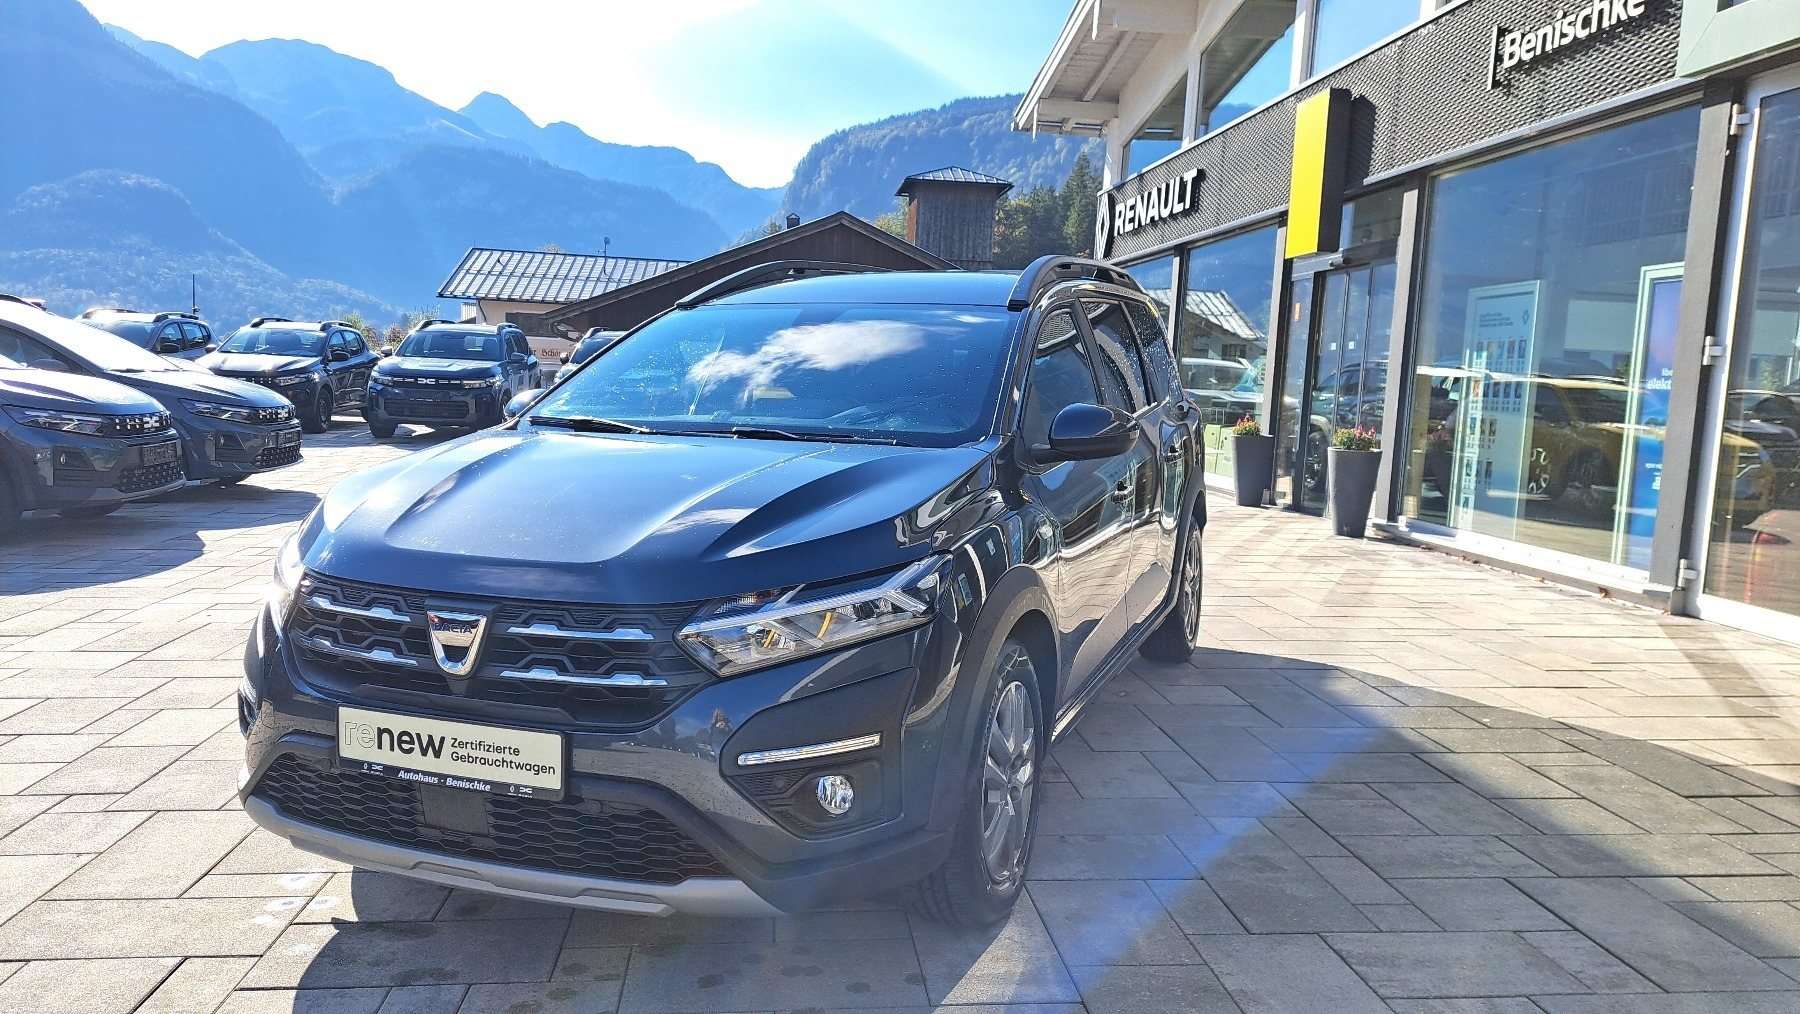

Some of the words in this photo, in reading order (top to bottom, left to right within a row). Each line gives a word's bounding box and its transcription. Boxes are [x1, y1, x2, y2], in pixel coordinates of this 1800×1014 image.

[1503, 0, 1645, 69] Benischke
[1113, 167, 1198, 237] RENAULT
[431, 622, 473, 634] DACIA
[344, 721, 446, 759] renew
[450, 737, 521, 757] Zertifizierte
[450, 751, 556, 776] Gebrauchtwagen
[397, 769, 439, 784] Autohaus
[445, 777, 491, 792] Benischke
